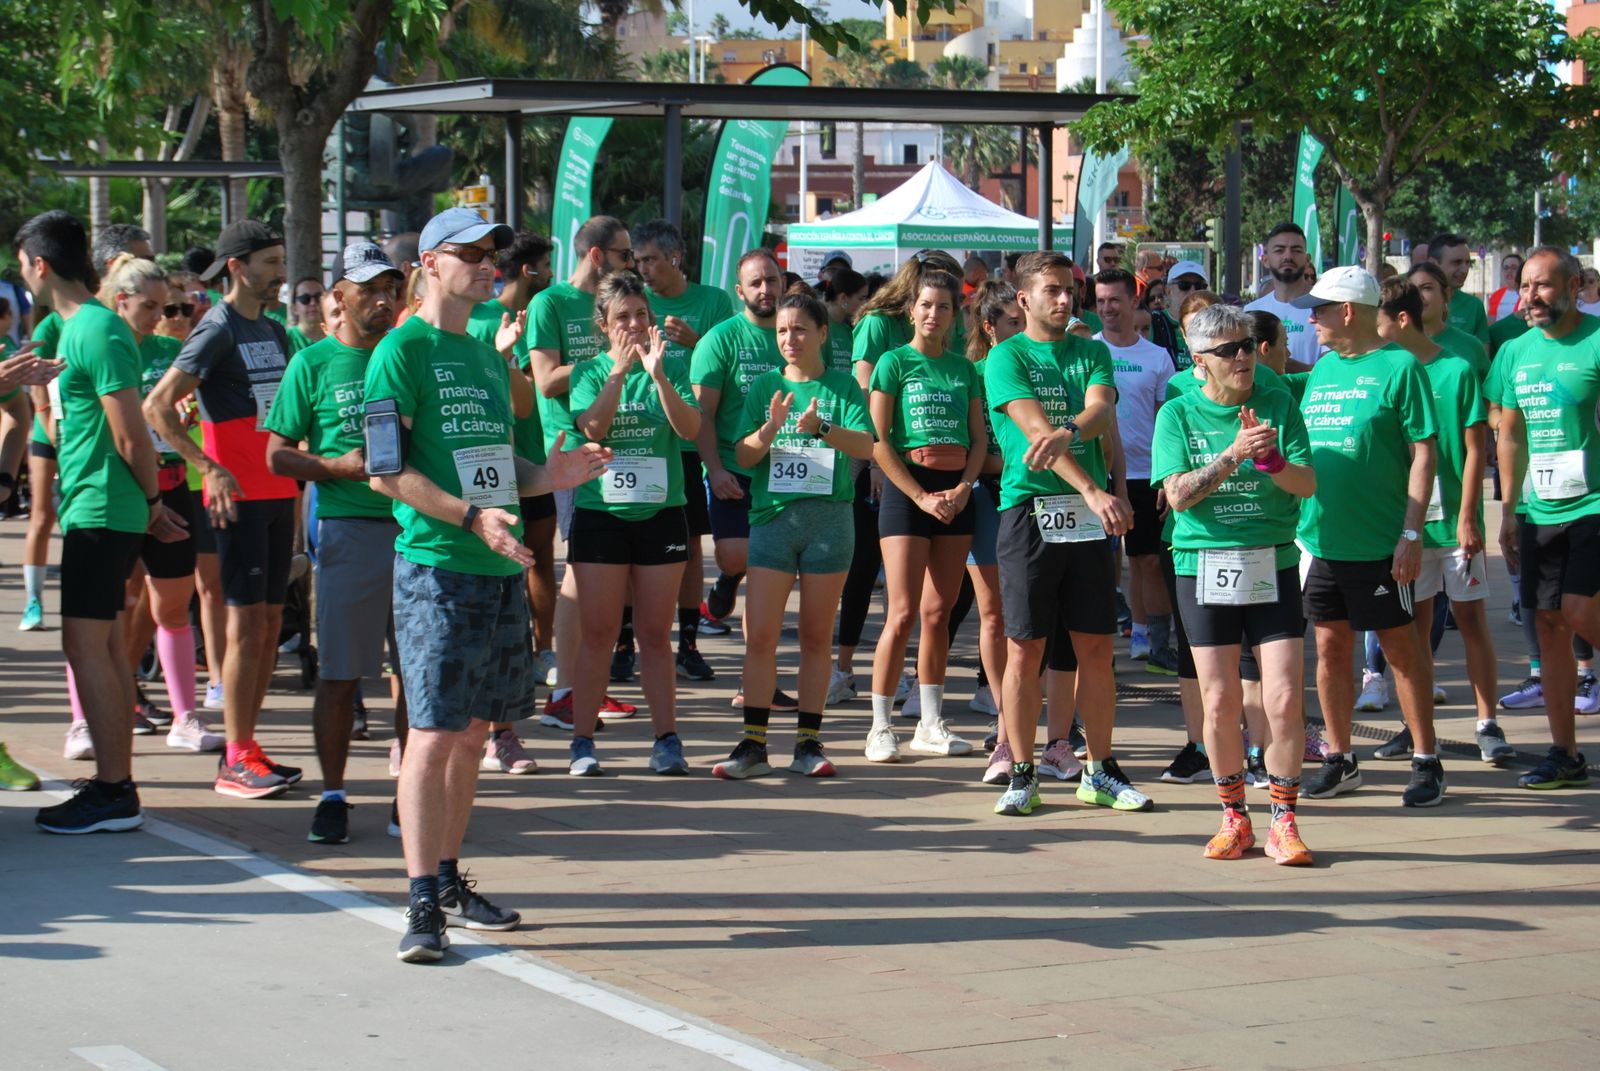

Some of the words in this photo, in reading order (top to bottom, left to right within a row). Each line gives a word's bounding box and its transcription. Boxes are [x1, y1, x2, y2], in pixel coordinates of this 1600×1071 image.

[730, 137, 767, 164] Tenemos
[726, 151, 739, 162] un
[738, 156, 760, 171] gran
[723, 162, 757, 181] camino
[720, 174, 737, 185] por
[719, 184, 753, 203] delante
[900, 231, 953, 243] ASOCIACIÓN
[953, 231, 997, 243] ESPAÑOLA
[996, 233, 1030, 244] CONTRA
[567, 323, 582, 334] En
[662, 350, 687, 358] ncer
[739, 350, 753, 360] En
[434, 368, 455, 382] En
[1029, 370, 1044, 382] En
[1515, 370, 1528, 383] En
[439, 385, 489, 399] marcha
[740, 383, 751, 394] el
[907, 381, 923, 393] En
[334, 389, 356, 403] En
[908, 391, 952, 404] marcha
[1309, 390, 1323, 402] En
[1323, 387, 1368, 401] marcha
[440, 400, 487, 416] contra
[909, 403, 946, 416] contra
[1303, 402, 1342, 415] contra
[342, 418, 358, 432] el
[441, 418, 460, 433] el
[461, 416, 505, 433] cáncer
[612, 414, 639, 426] ntra
[911, 416, 923, 429] el
[924, 416, 960, 429] cáncer
[1313, 414, 1354, 427] cáncer
[611, 426, 656, 439] cáncer
[1530, 428, 1565, 438] SKODA
[776, 435, 823, 448] cáncer
[1189, 437, 1207, 449] En
[1190, 452, 1219, 464] mar
[773, 462, 808, 479] 349
[473, 466, 500, 490] 49
[613, 471, 637, 489] 59
[1536, 469, 1554, 486] 77
[1213, 502, 1262, 514] SKODA
[1040, 511, 1077, 531] 205
[1216, 568, 1243, 588] 57
